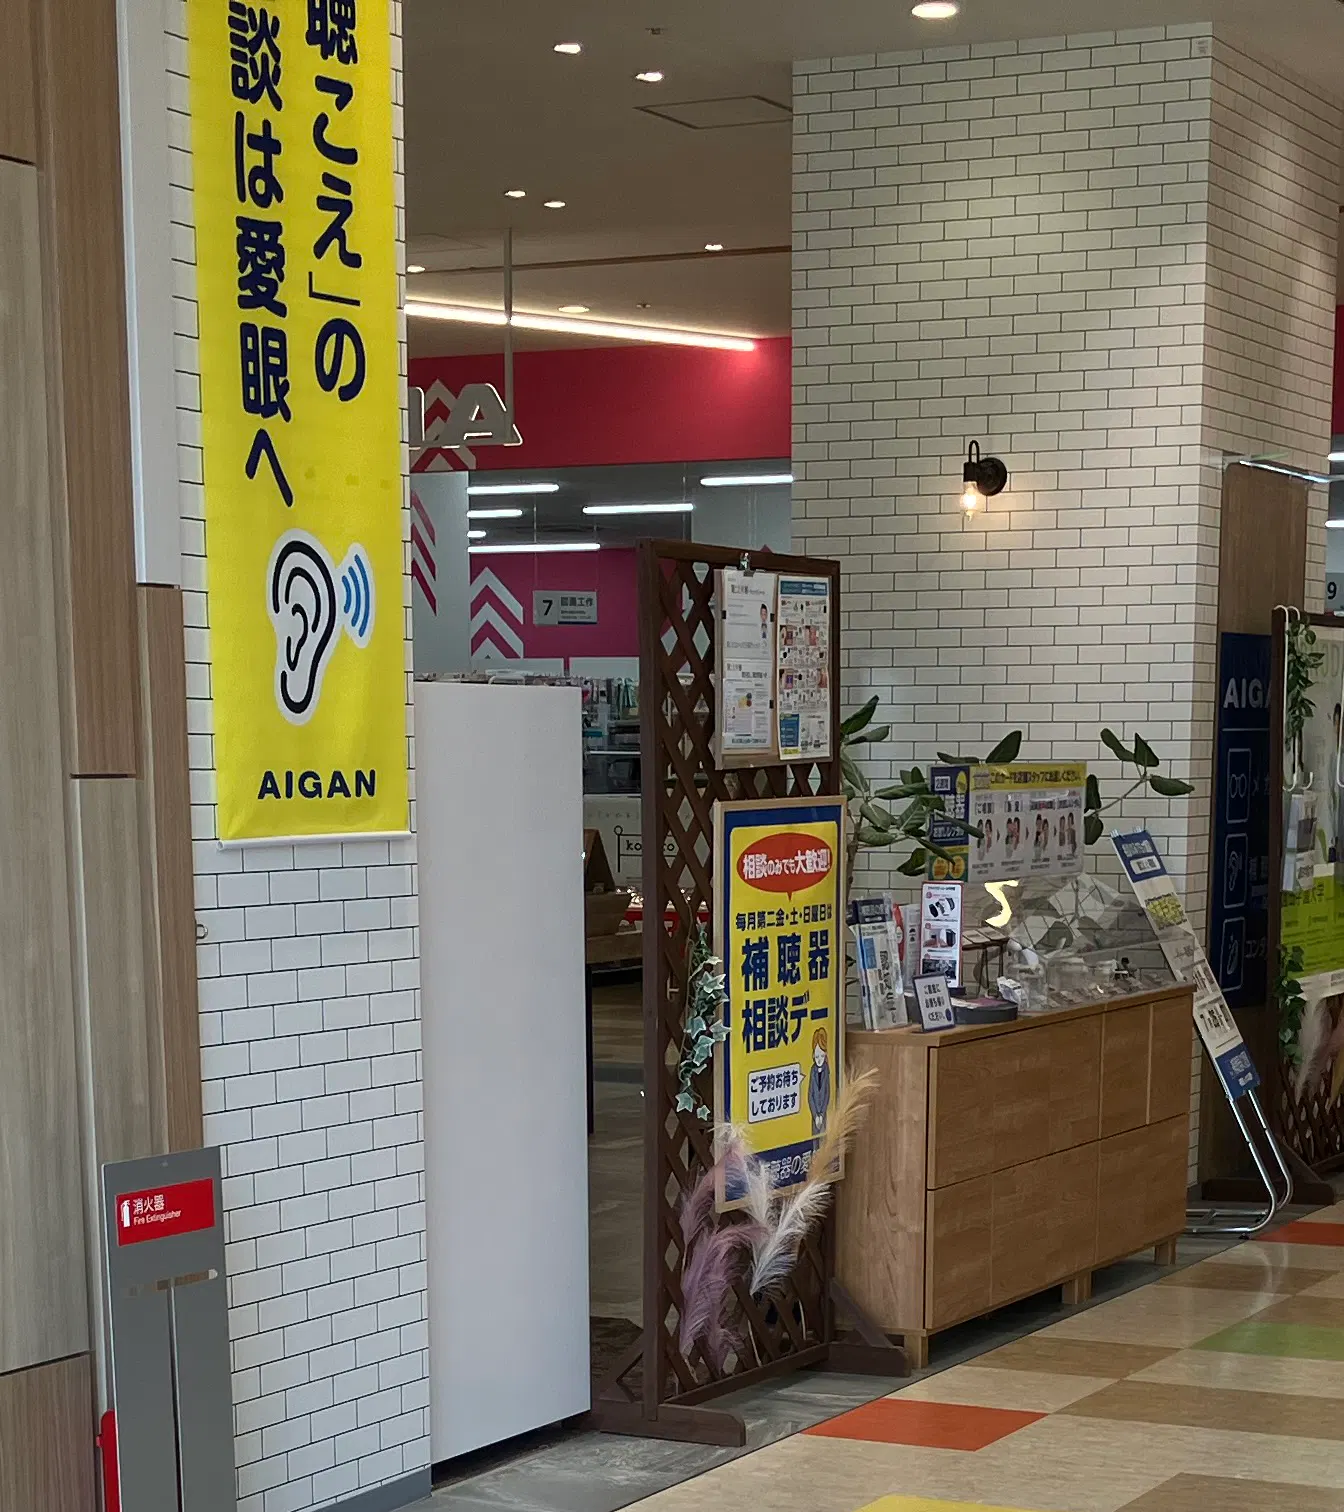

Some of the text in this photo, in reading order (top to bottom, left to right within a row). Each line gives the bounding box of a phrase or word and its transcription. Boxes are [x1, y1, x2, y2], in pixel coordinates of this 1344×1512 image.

[1327, 581, 1337, 600] 9
[542, 599, 553, 616] 7
[257, 769, 377, 801] AIGAN
[741, 929, 831, 992] 補聴器
[741, 988, 830, 1054] 相談デー
[750, 1069, 799, 1093] ご予約お待ち
[751, 1091, 798, 1116] しております
[132, 1194, 165, 1215] 消火器
[133, 1209, 182, 1226] Fire Extinguisher
